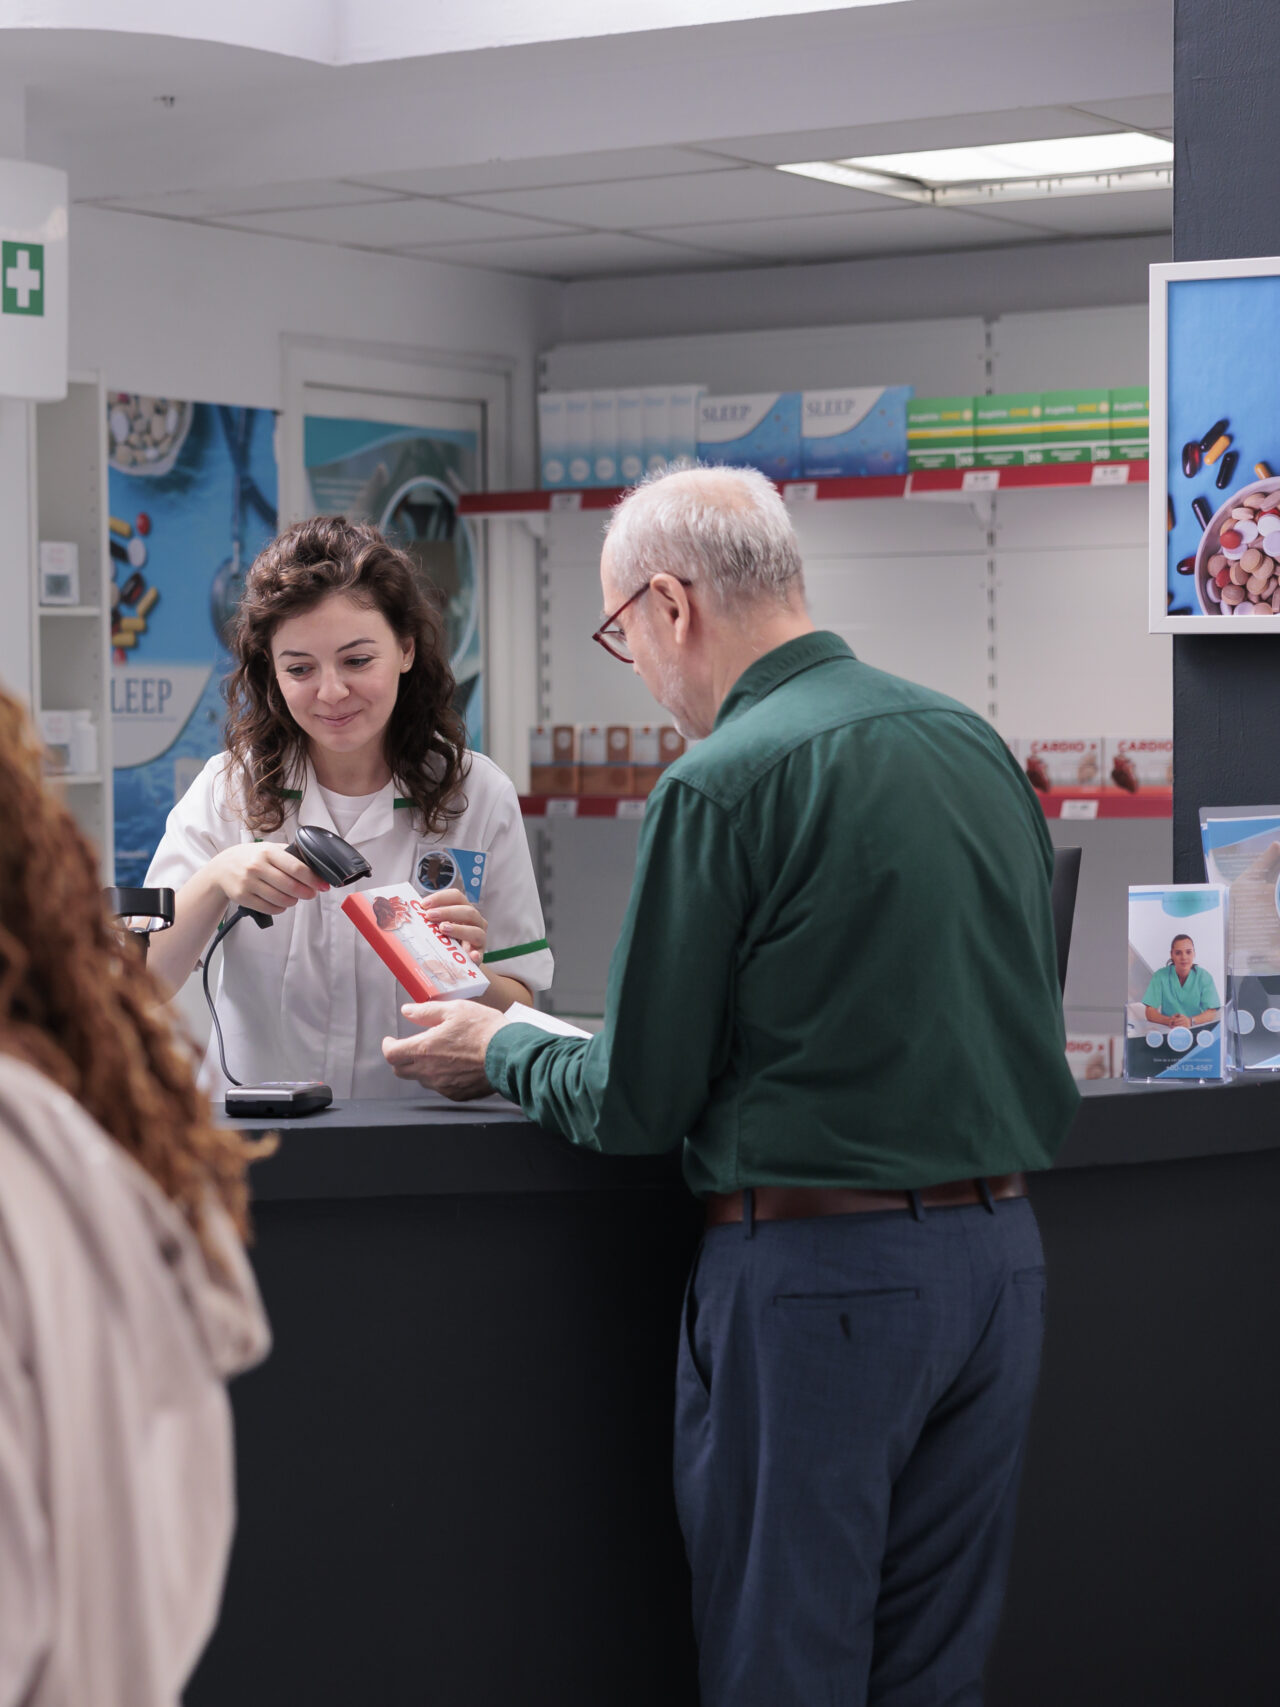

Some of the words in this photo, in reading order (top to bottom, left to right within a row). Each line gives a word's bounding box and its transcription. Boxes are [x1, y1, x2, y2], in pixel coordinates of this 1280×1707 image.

[702, 405, 752, 422] SLEEP
[805, 399, 855, 417] SLEEP
[111, 678, 172, 714] LEEP
[1030, 741, 1085, 753] CARDIO
[409, 899, 467, 965] CARDIO
[1066, 1041, 1093, 1053] DIO
